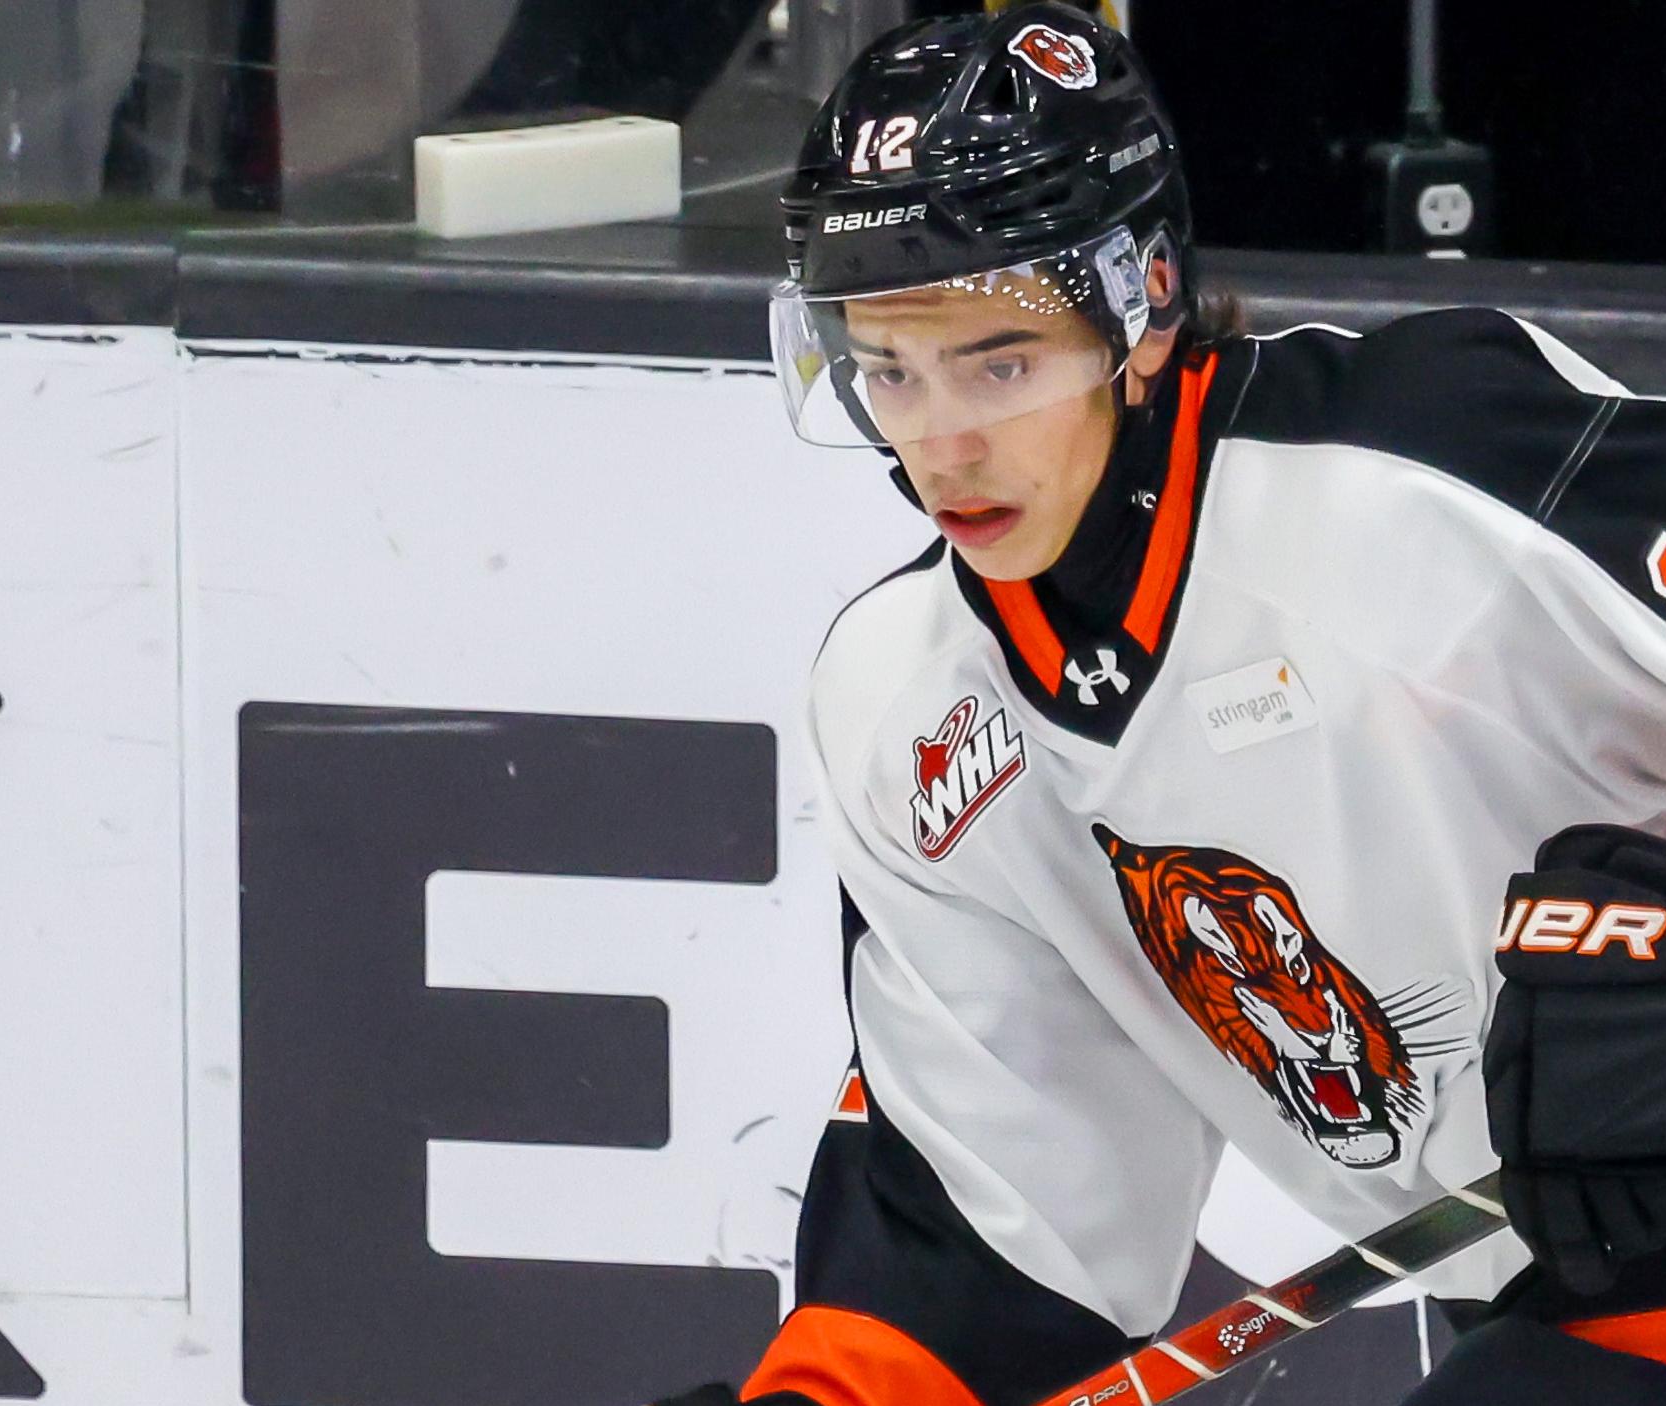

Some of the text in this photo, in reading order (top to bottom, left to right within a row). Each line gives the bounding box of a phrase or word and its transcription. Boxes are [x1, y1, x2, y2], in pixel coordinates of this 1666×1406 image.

[849, 116, 919, 174] 12
[1207, 690, 1288, 729] stringam
[910, 708, 1024, 842] WHL
[1093, 1380, 1130, 1406] PRO
